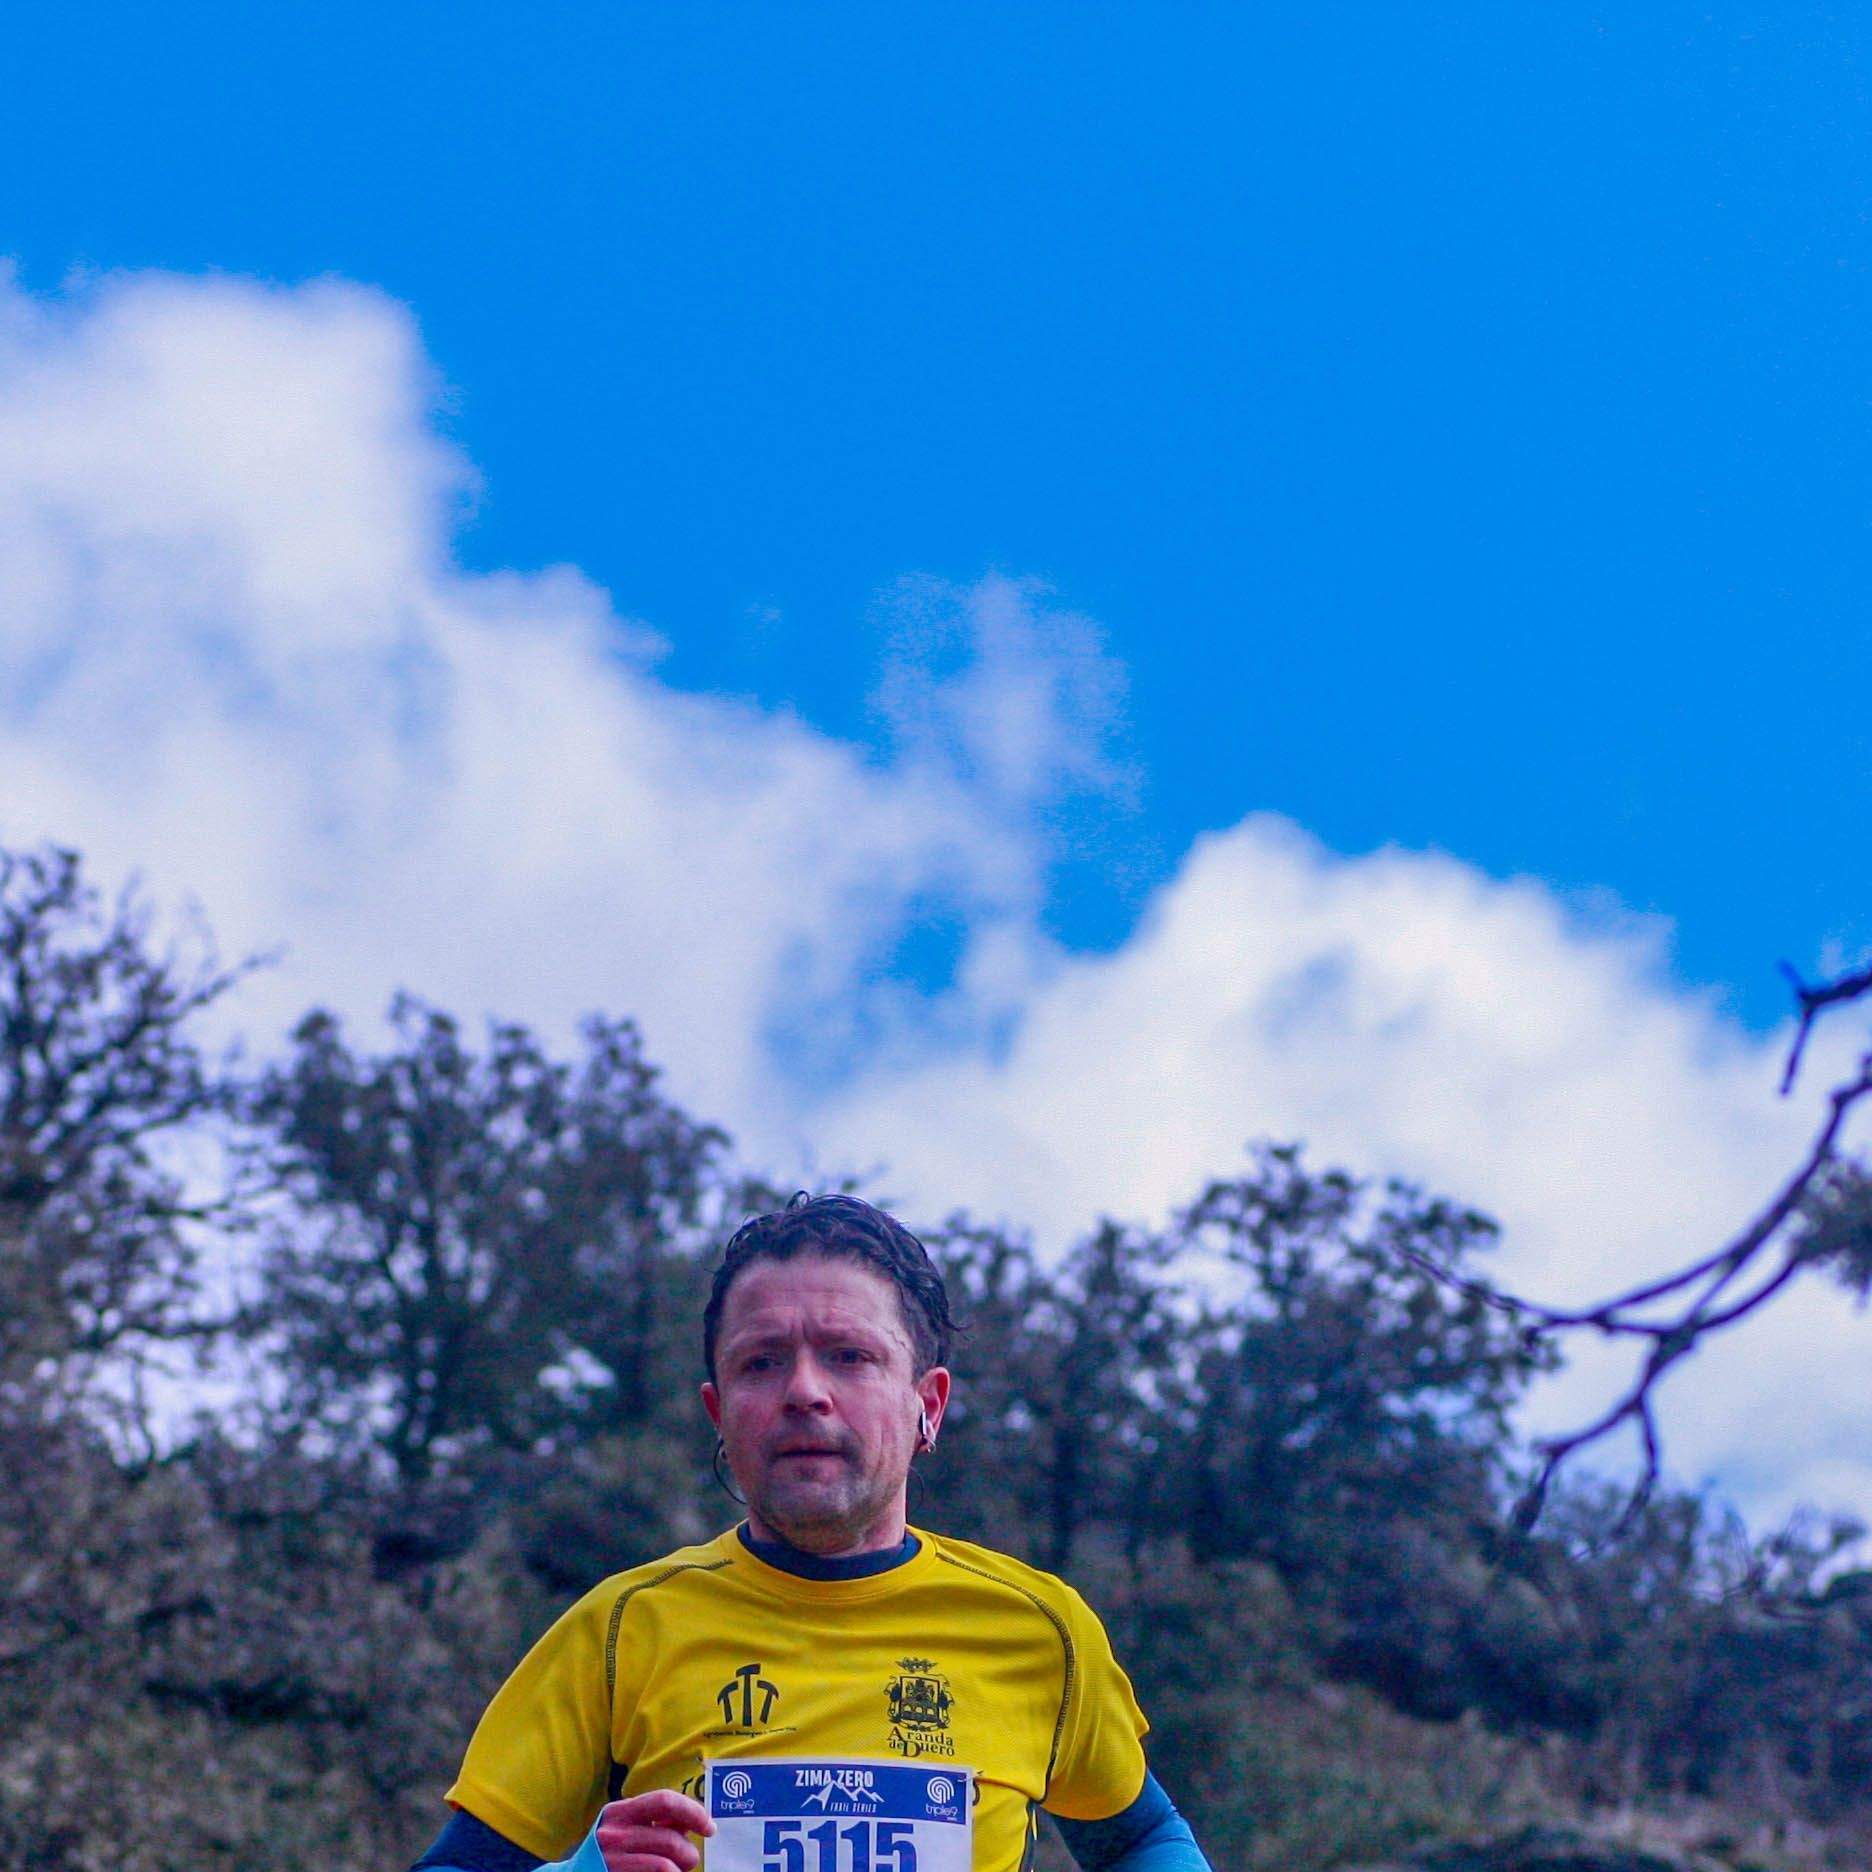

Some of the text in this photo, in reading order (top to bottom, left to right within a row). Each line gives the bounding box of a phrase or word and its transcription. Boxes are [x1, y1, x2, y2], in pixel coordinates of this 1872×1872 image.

[887, 1726, 953, 1745] Aranda
[889, 1739, 955, 1757] de Duero
[795, 1769, 874, 1788] ZIMA ZERO
